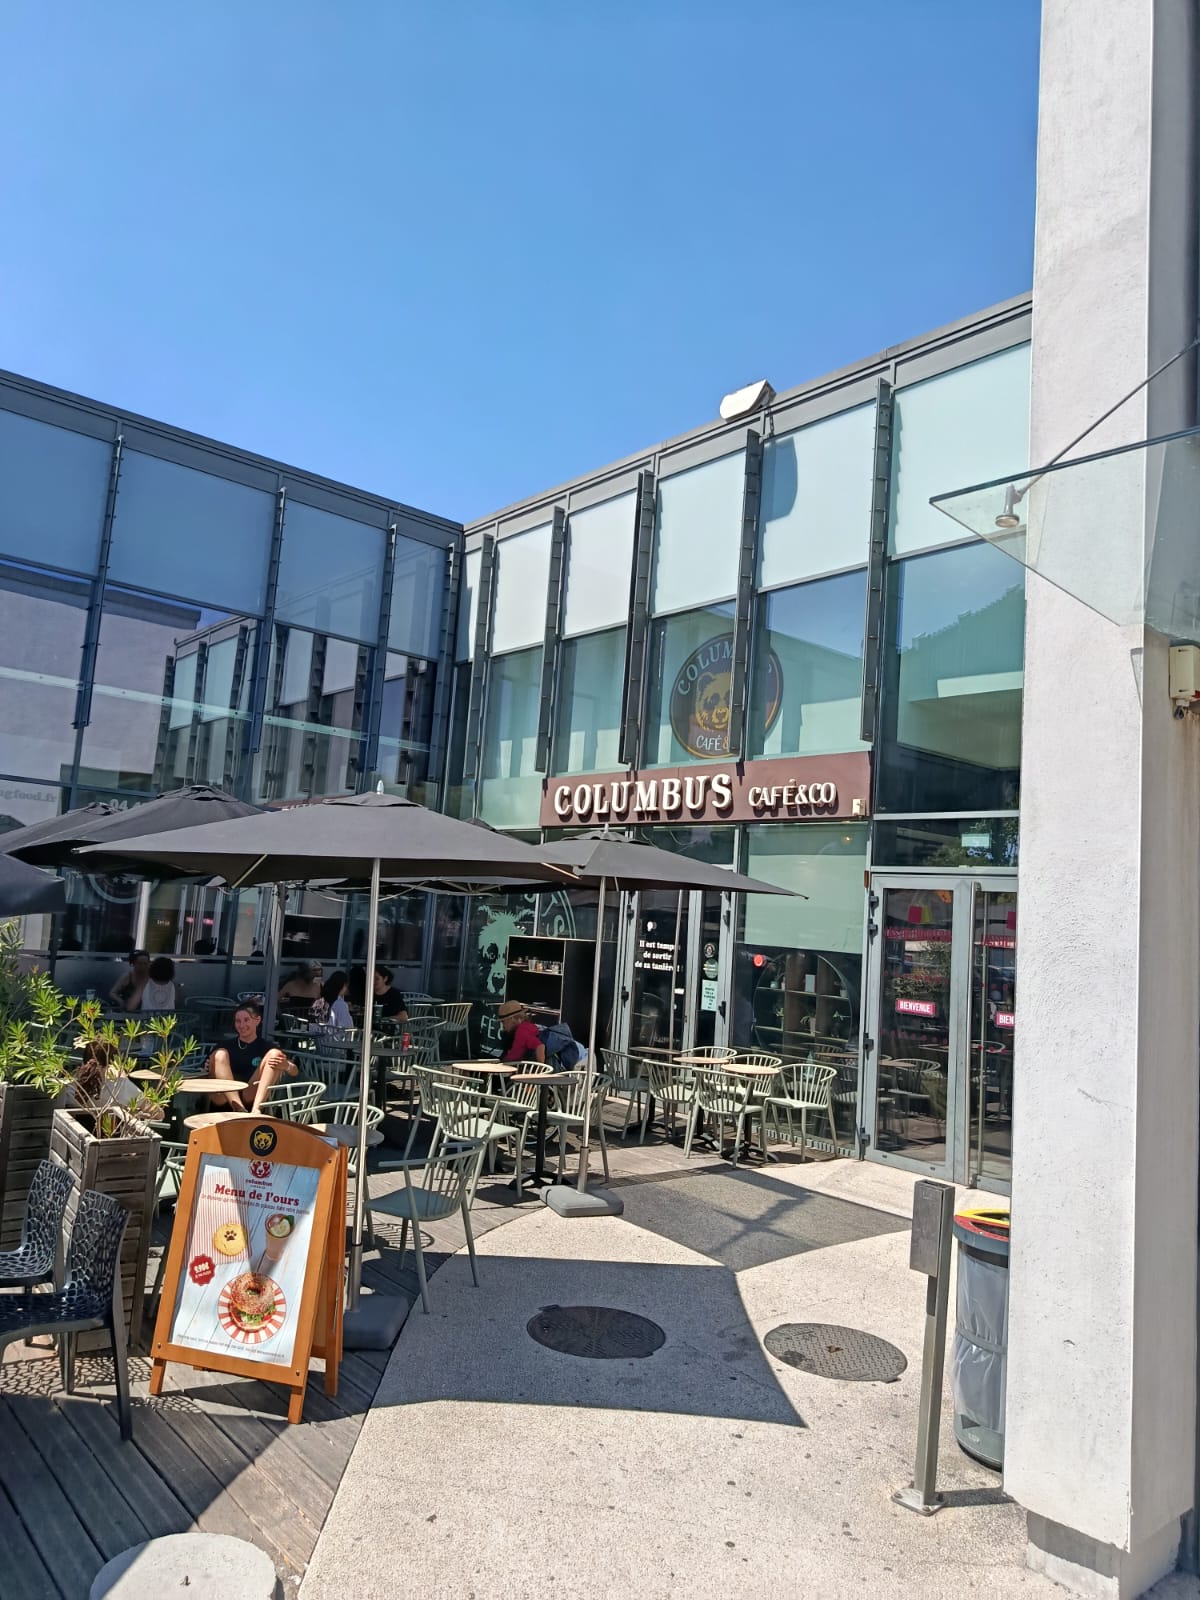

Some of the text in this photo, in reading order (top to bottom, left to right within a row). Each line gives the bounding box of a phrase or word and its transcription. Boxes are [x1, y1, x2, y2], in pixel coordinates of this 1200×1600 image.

[554, 773, 838, 816] COLUMBUS CAFÉ&CO
[645, 941, 656, 949] est
[656, 942, 680, 951] temp
[643, 950, 672, 961] de sortir
[899, 1000, 931, 1013] BIENVENUE
[214, 1183, 246, 1198] Menu
[249, 1189, 263, 1200] de
[265, 1191, 300, 1206] l'ours
